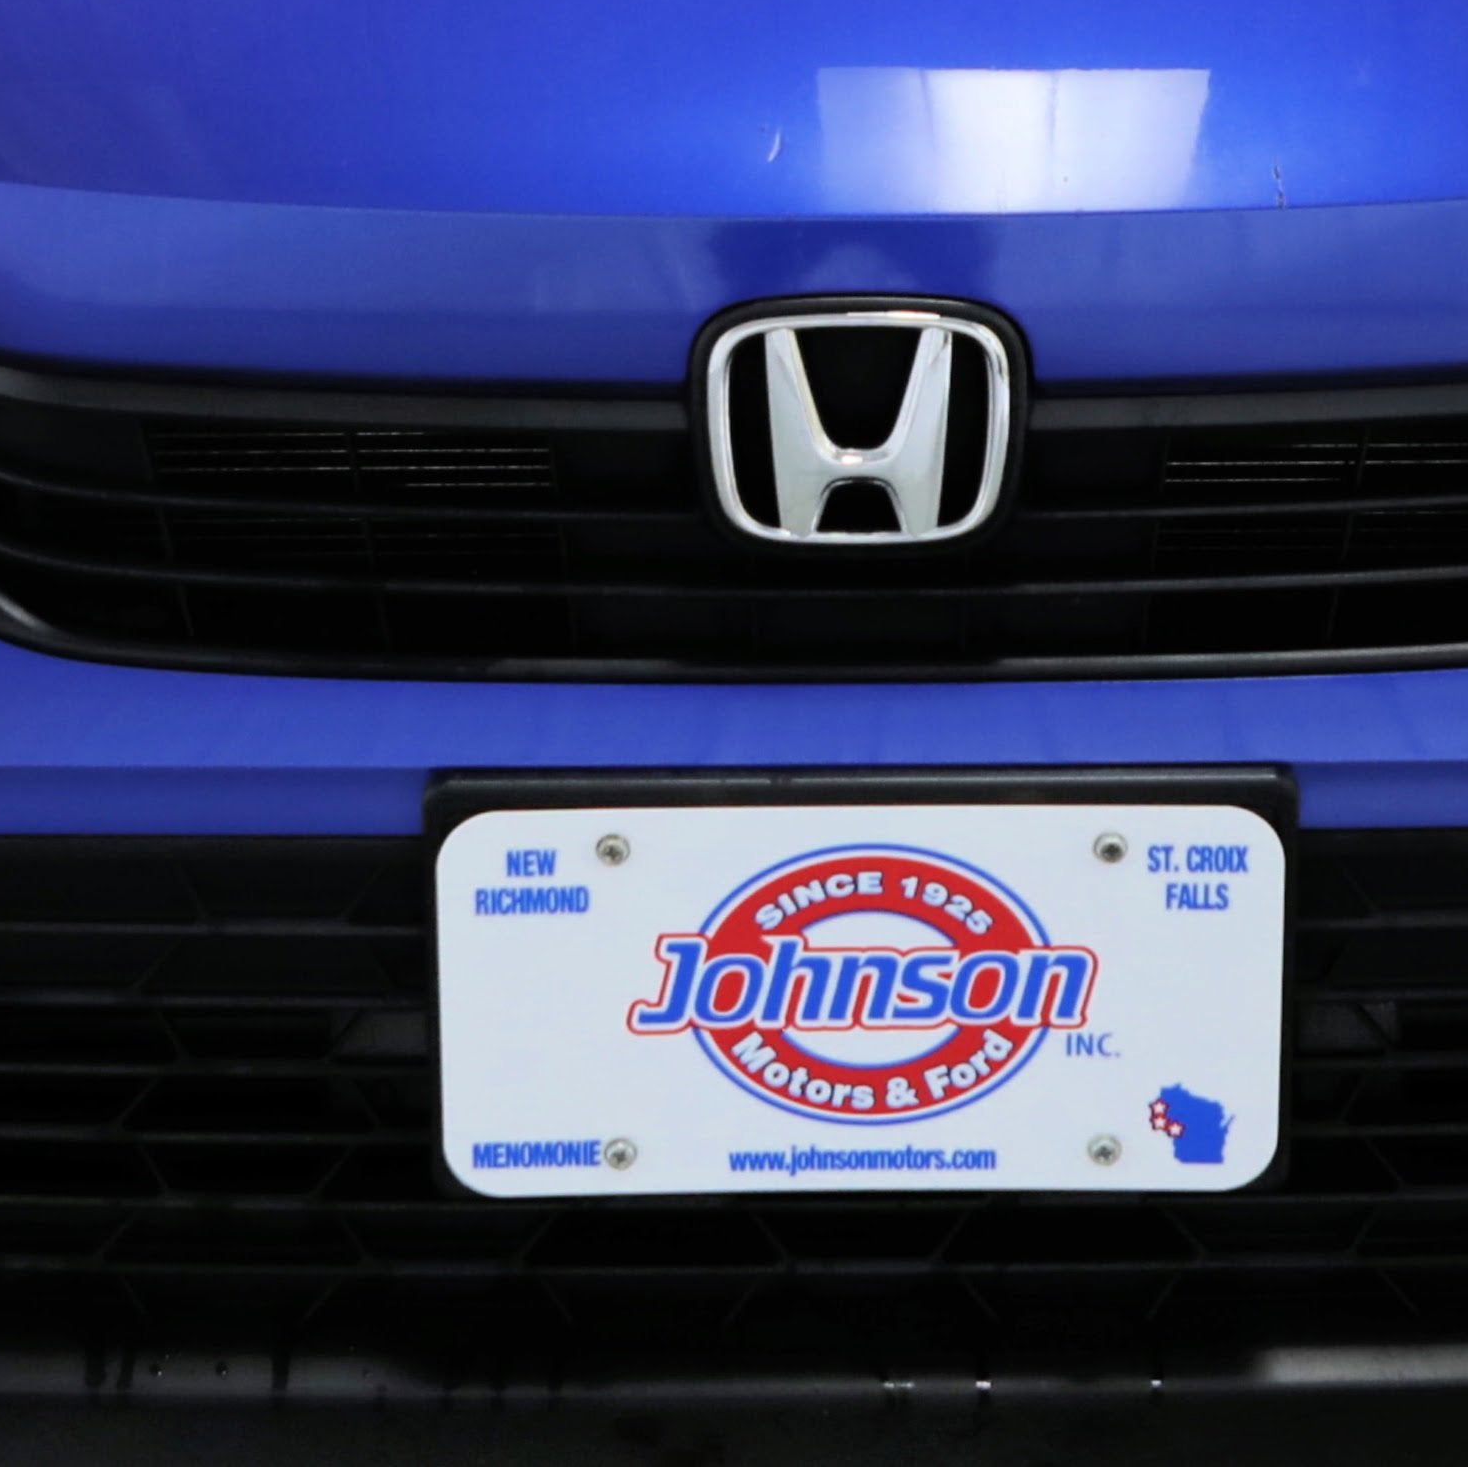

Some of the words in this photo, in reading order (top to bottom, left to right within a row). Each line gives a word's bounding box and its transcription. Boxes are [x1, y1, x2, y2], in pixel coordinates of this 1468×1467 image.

[506, 849, 557, 877] NEW
[1147, 845, 1179, 872] ST.
[1186, 845, 1249, 873] CROIX
[475, 886, 589, 916] RICHMOND
[755, 871, 884, 930] SINCE
[900, 875, 994, 935] 1925
[1165, 883, 1229, 910] FALLS
[635, 937, 1091, 1026] Johnson
[1065, 1033, 1121, 1058] INC.
[731, 1032, 875, 1110] Motors
[885, 1077, 918, 1109] &
[924, 1029, 1014, 1100] Ford
[473, 1140, 601, 1169] MENOMONIE
[729, 1145, 996, 1176] www.johnsonmotors.com
